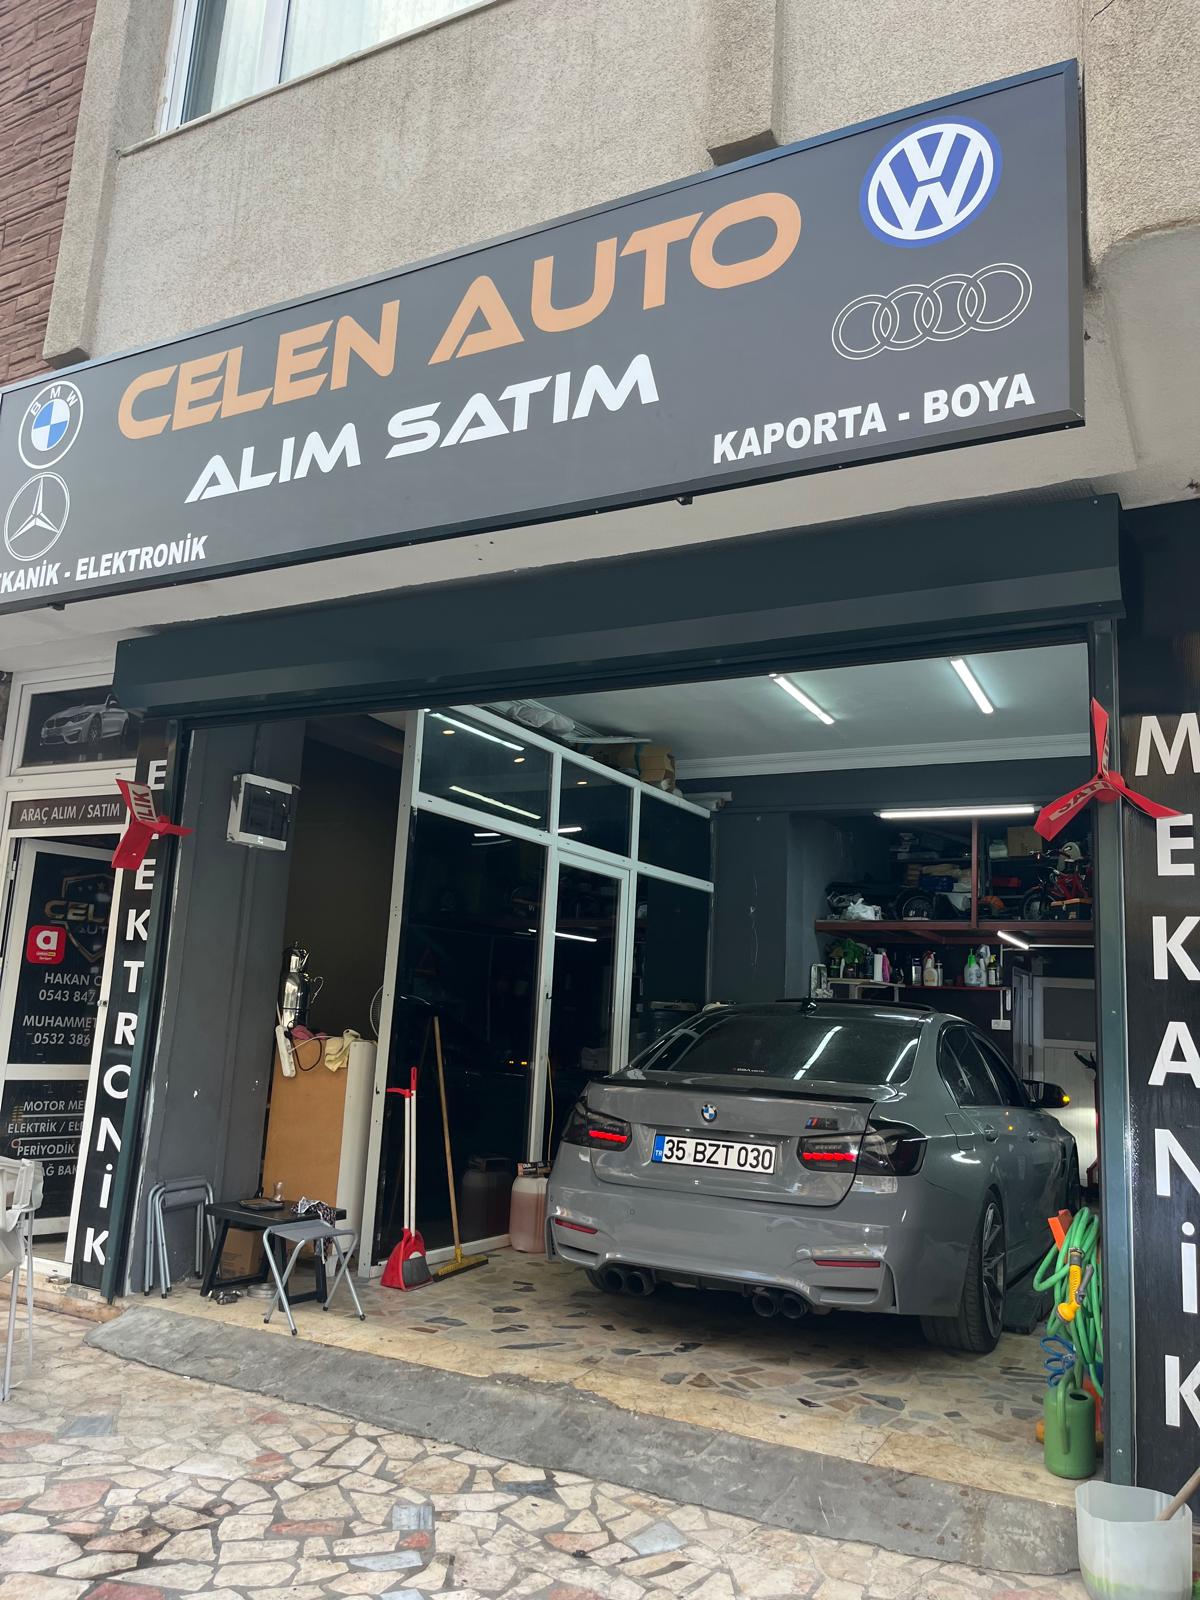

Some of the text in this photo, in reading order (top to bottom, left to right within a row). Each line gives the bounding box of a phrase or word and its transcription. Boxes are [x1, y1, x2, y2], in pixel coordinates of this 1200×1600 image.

[117, 192, 801, 439] CELEN AUTO
[30, 385, 78, 416] BMW
[184, 353, 659, 504] ALIM SATIM
[712, 402, 887, 464] KAPORTA
[923, 373, 1035, 425] BOYA
[0, 560, 61, 594] KANİK
[76, 533, 208, 581] ELEKTRONİK
[20, 808, 49, 825] ARAÇ
[51, 806, 76, 820] ALIM
[87, 803, 120, 818] SATIM
[44, 972, 90, 986] HAKAN
[39, 989, 70, 1001] 0543
[82, 760, 167, 1266] EEKTRONİK
[34, 1032, 65, 1045] 0532
[23, 1101, 65, 1112] MOTOR
[8, 1119, 57, 1134] ELEKTRİK
[17, 1141, 75, 1156] PERİYODİK
[664, 1139, 773, 1170] 35 BZT 030
